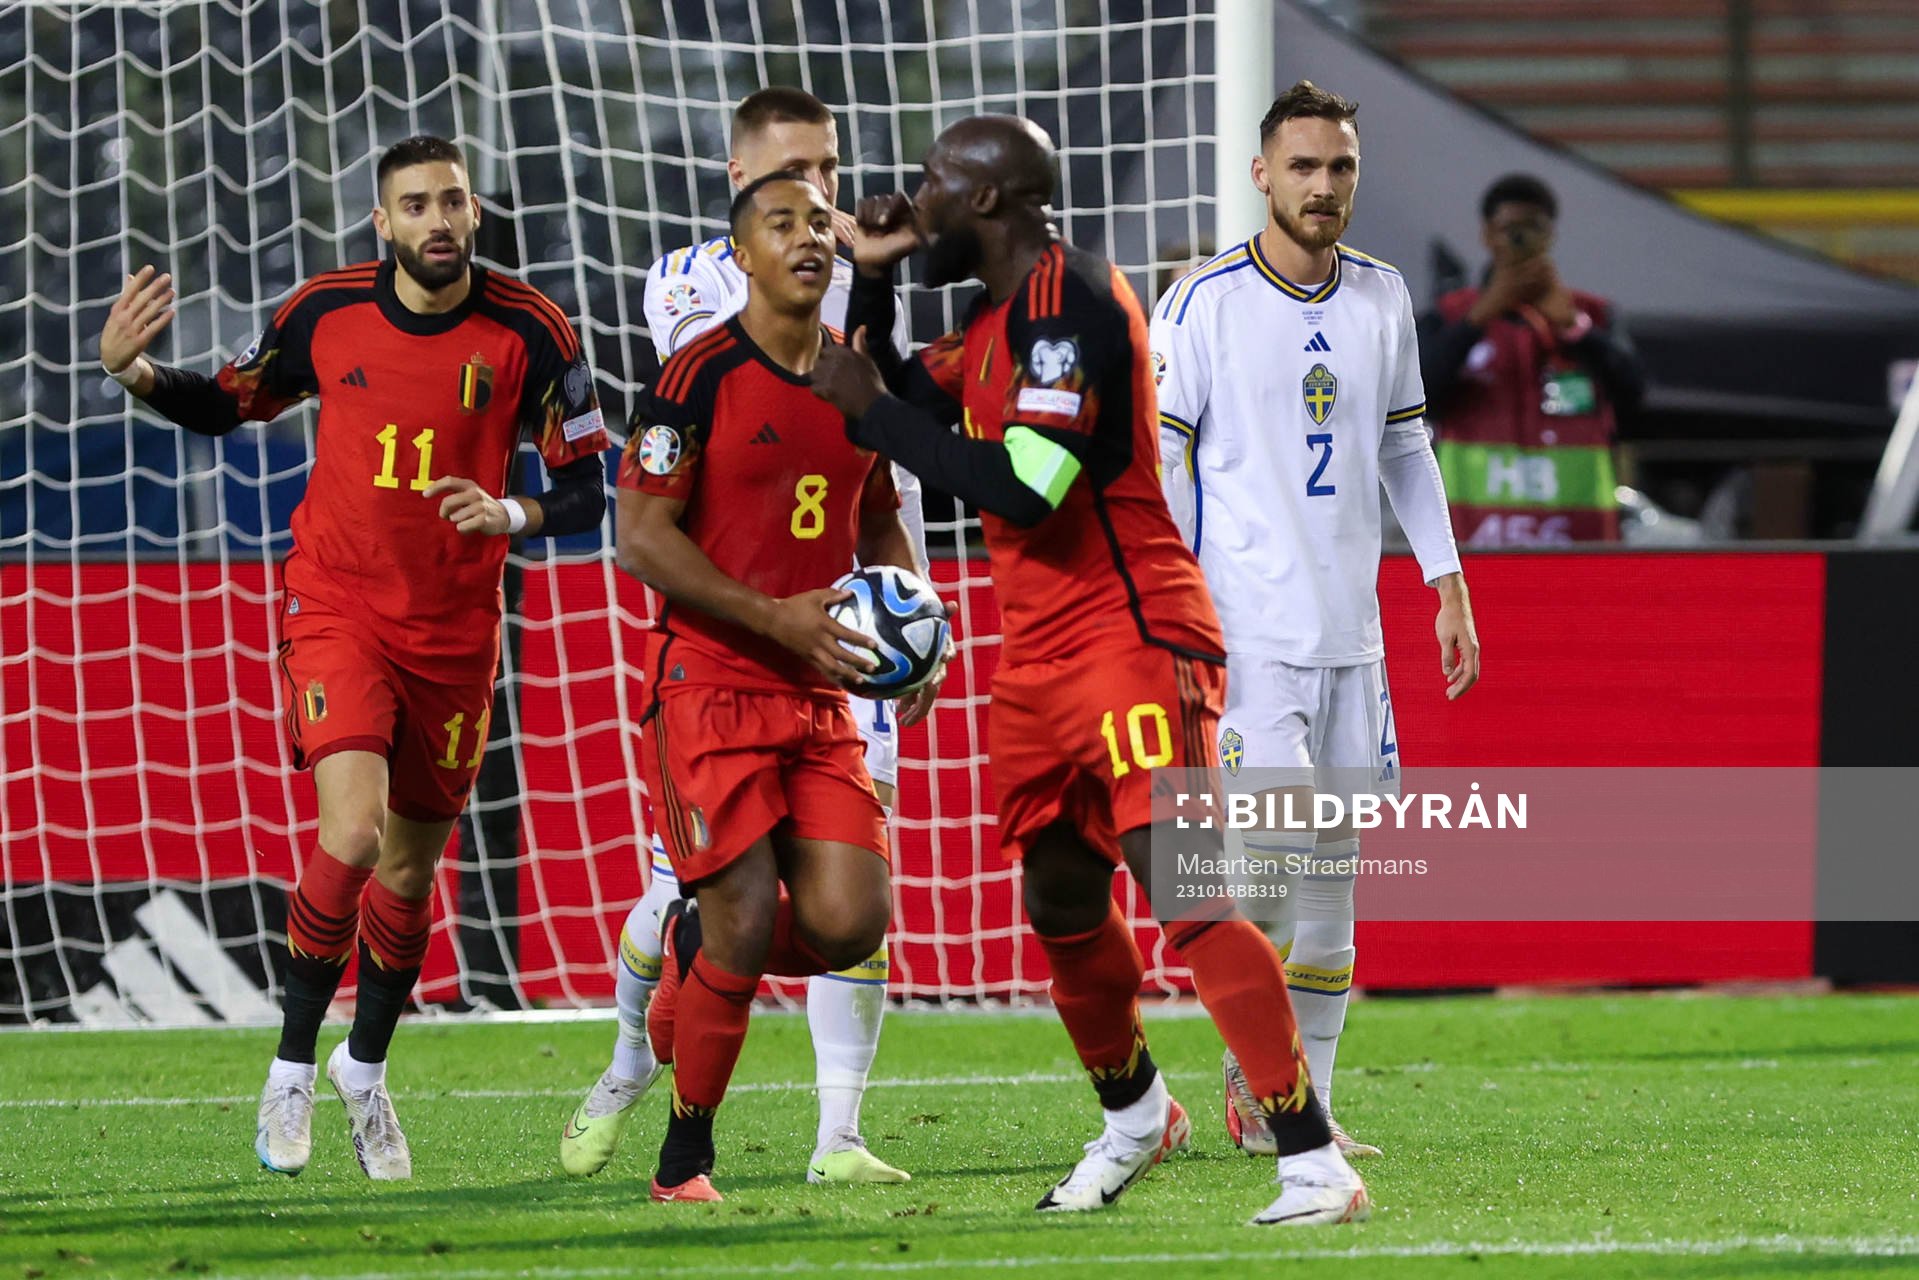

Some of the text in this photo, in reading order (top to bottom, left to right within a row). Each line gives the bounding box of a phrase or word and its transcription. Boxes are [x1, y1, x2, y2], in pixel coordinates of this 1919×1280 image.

[373, 423, 435, 491] 11
[1305, 433, 1336, 497] 2
[790, 474, 828, 539] 8
[1100, 703, 1174, 779] 10
[1380, 691, 1396, 756] 2
